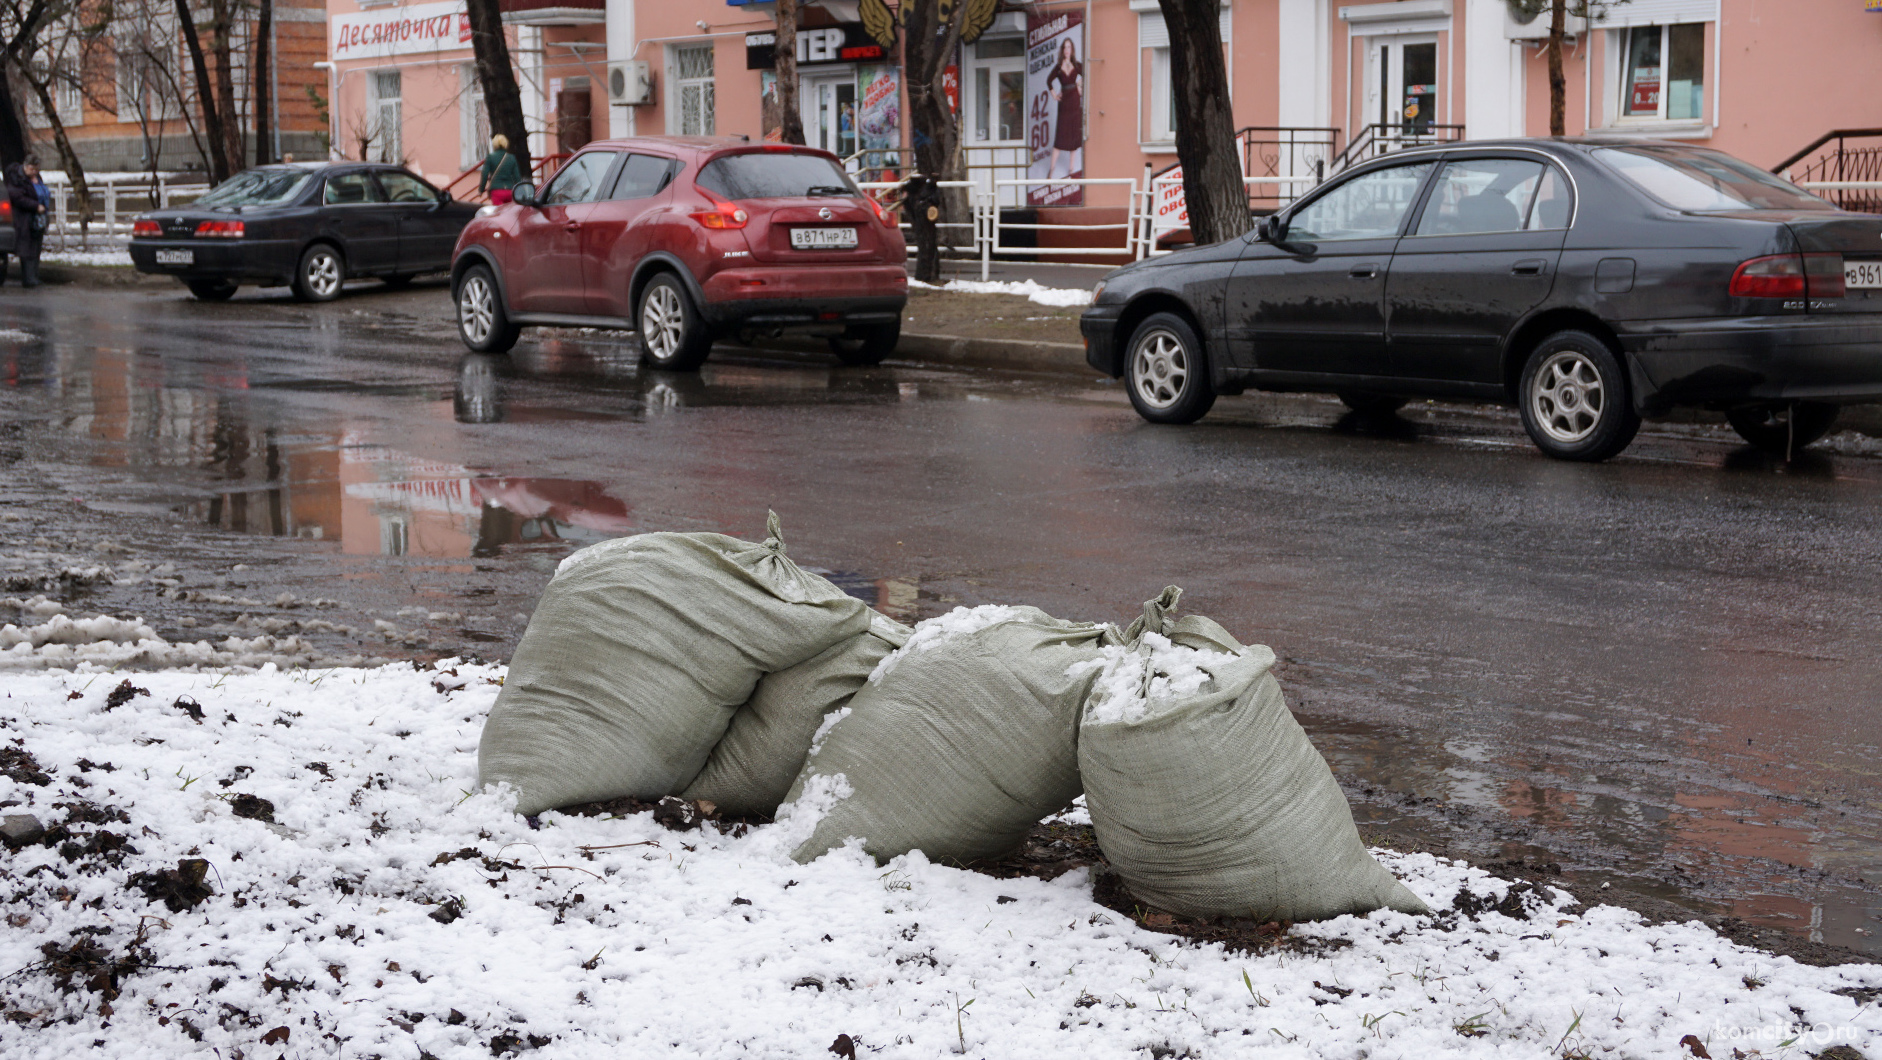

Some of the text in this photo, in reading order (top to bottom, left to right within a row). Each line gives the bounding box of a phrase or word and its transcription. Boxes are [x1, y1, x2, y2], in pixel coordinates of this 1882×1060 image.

[337, 14, 451, 53] Десяточка
[746, 33, 776, 47] ОБУВЬ
[1029, 14, 1068, 46] СТИЛЬНАЯ
[1030, 39, 1057, 61] ЖЕНСКАЯ
[1029, 54, 1054, 75] ОДЕЖДА
[864, 81, 896, 110] УДОБНО
[865, 74, 890, 96] ЛЕГКО
[1031, 90, 1049, 121] 42
[1031, 120, 1049, 151] 60
[1164, 185, 1182, 200] ПР
[1159, 197, 1186, 216] ОВО
[796, 230, 839, 243] В871НР
